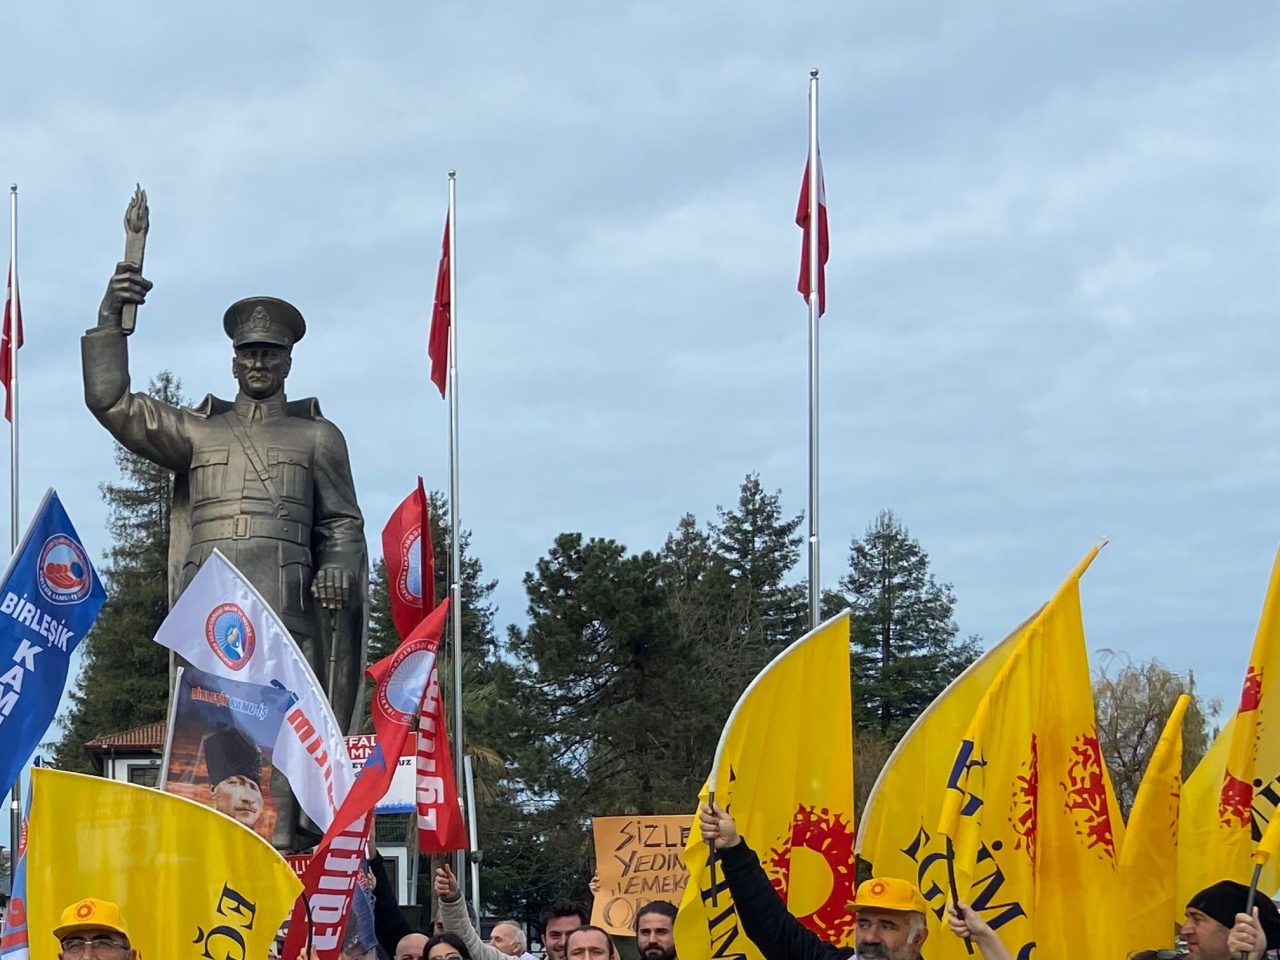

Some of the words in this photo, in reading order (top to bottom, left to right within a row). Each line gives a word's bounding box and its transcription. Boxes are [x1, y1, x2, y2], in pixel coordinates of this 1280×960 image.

[0, 590, 75, 652] BİRLEŞİK
[615, 820, 692, 852] SİZLE
[614, 848, 687, 878] YEDİN
